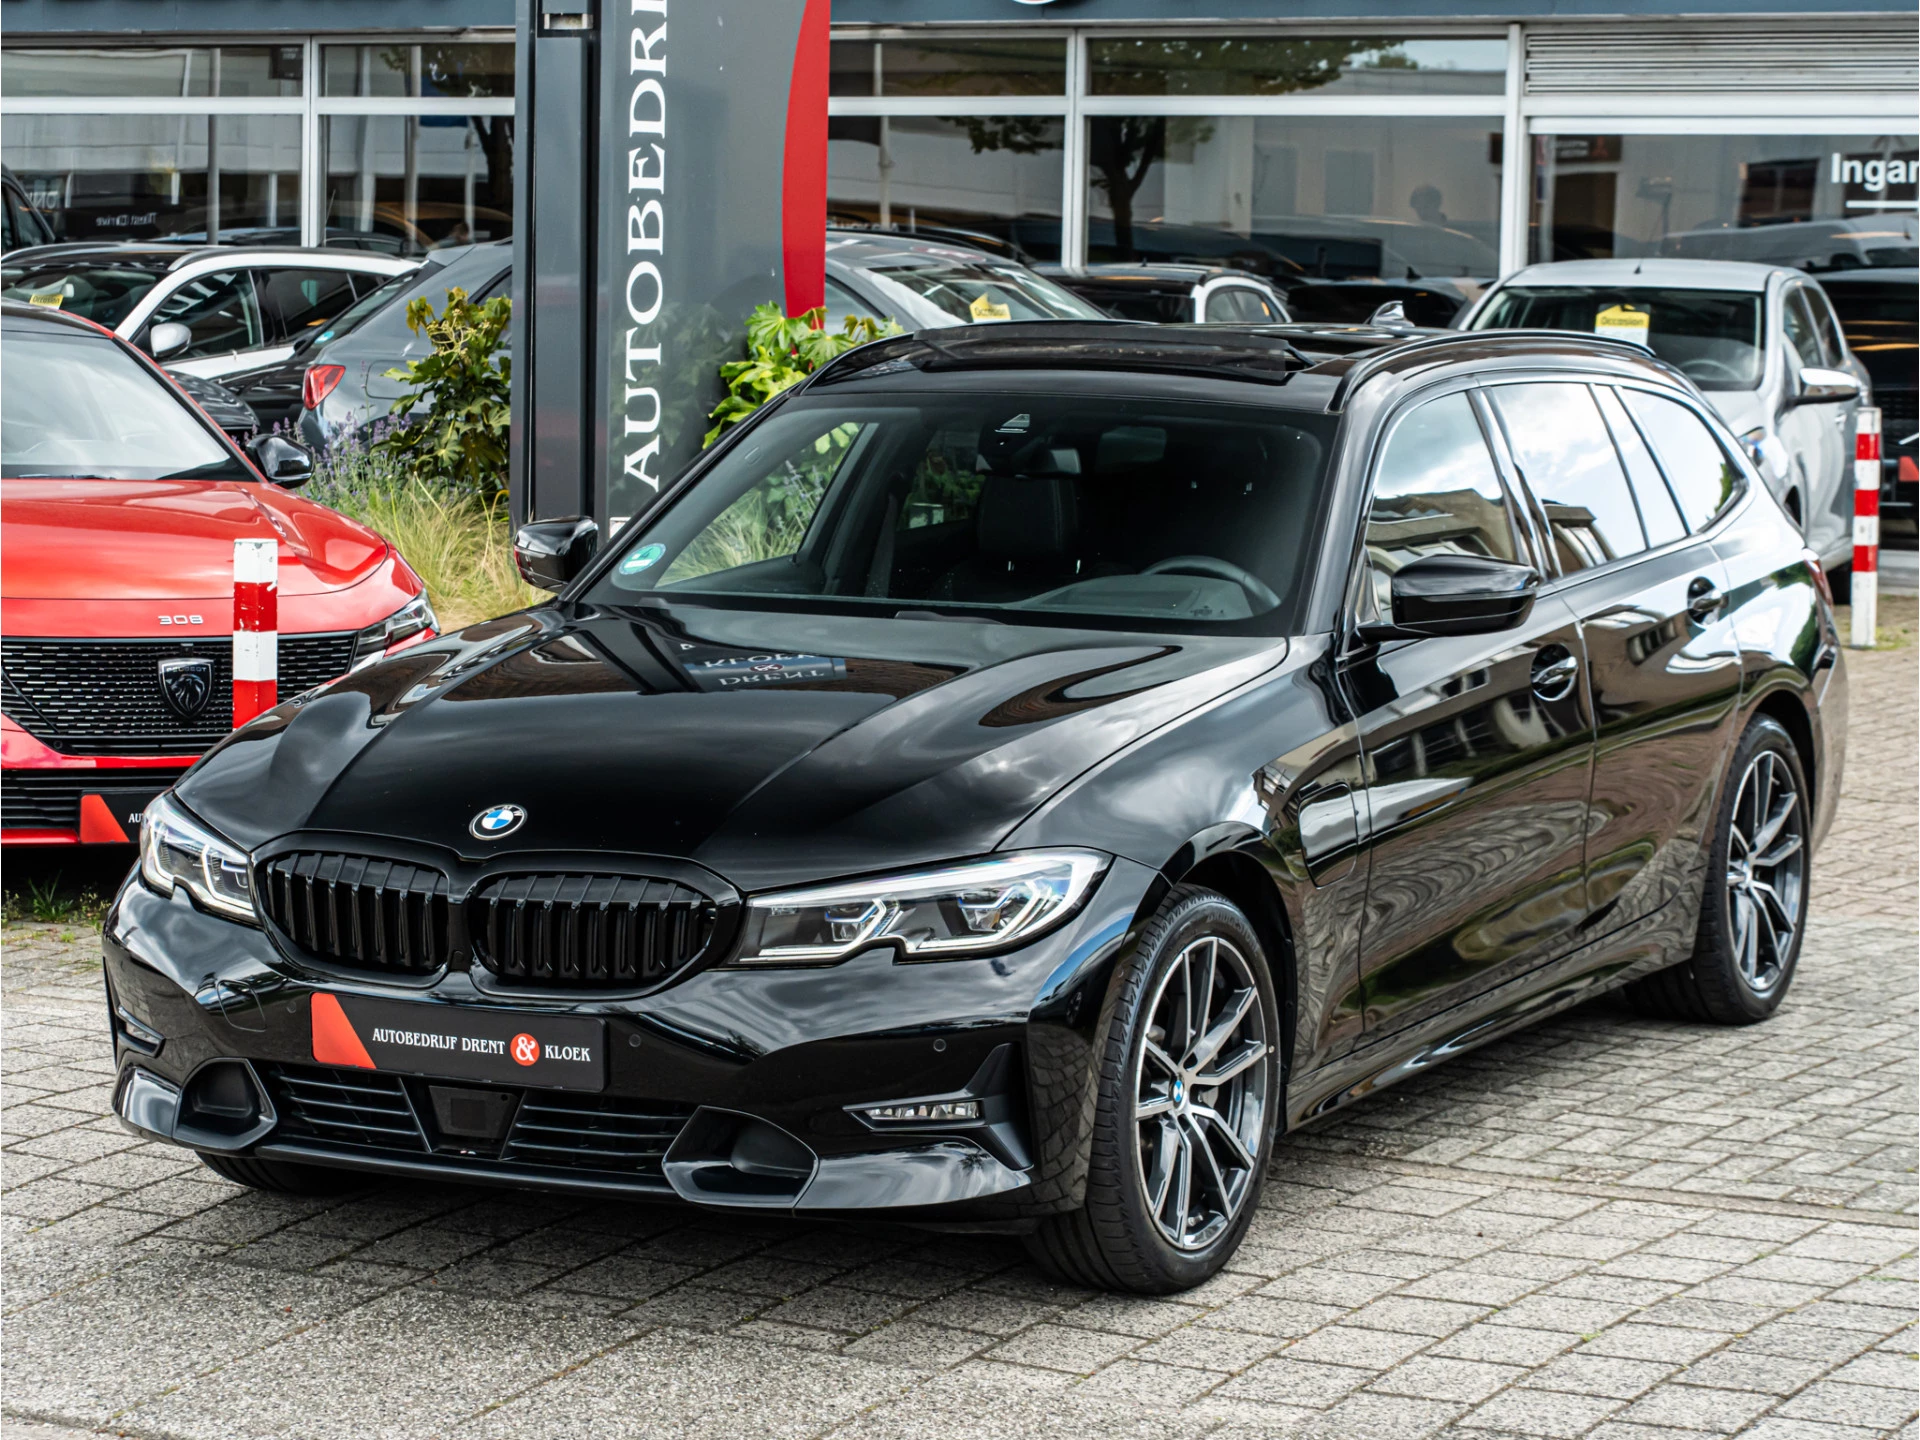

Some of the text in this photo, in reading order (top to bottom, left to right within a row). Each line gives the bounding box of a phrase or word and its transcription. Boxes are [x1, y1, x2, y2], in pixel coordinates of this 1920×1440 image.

[158, 614, 204, 625] 308
[372, 1028, 592, 1062] AUTOBEDRIJF DRENT & KLOEK
